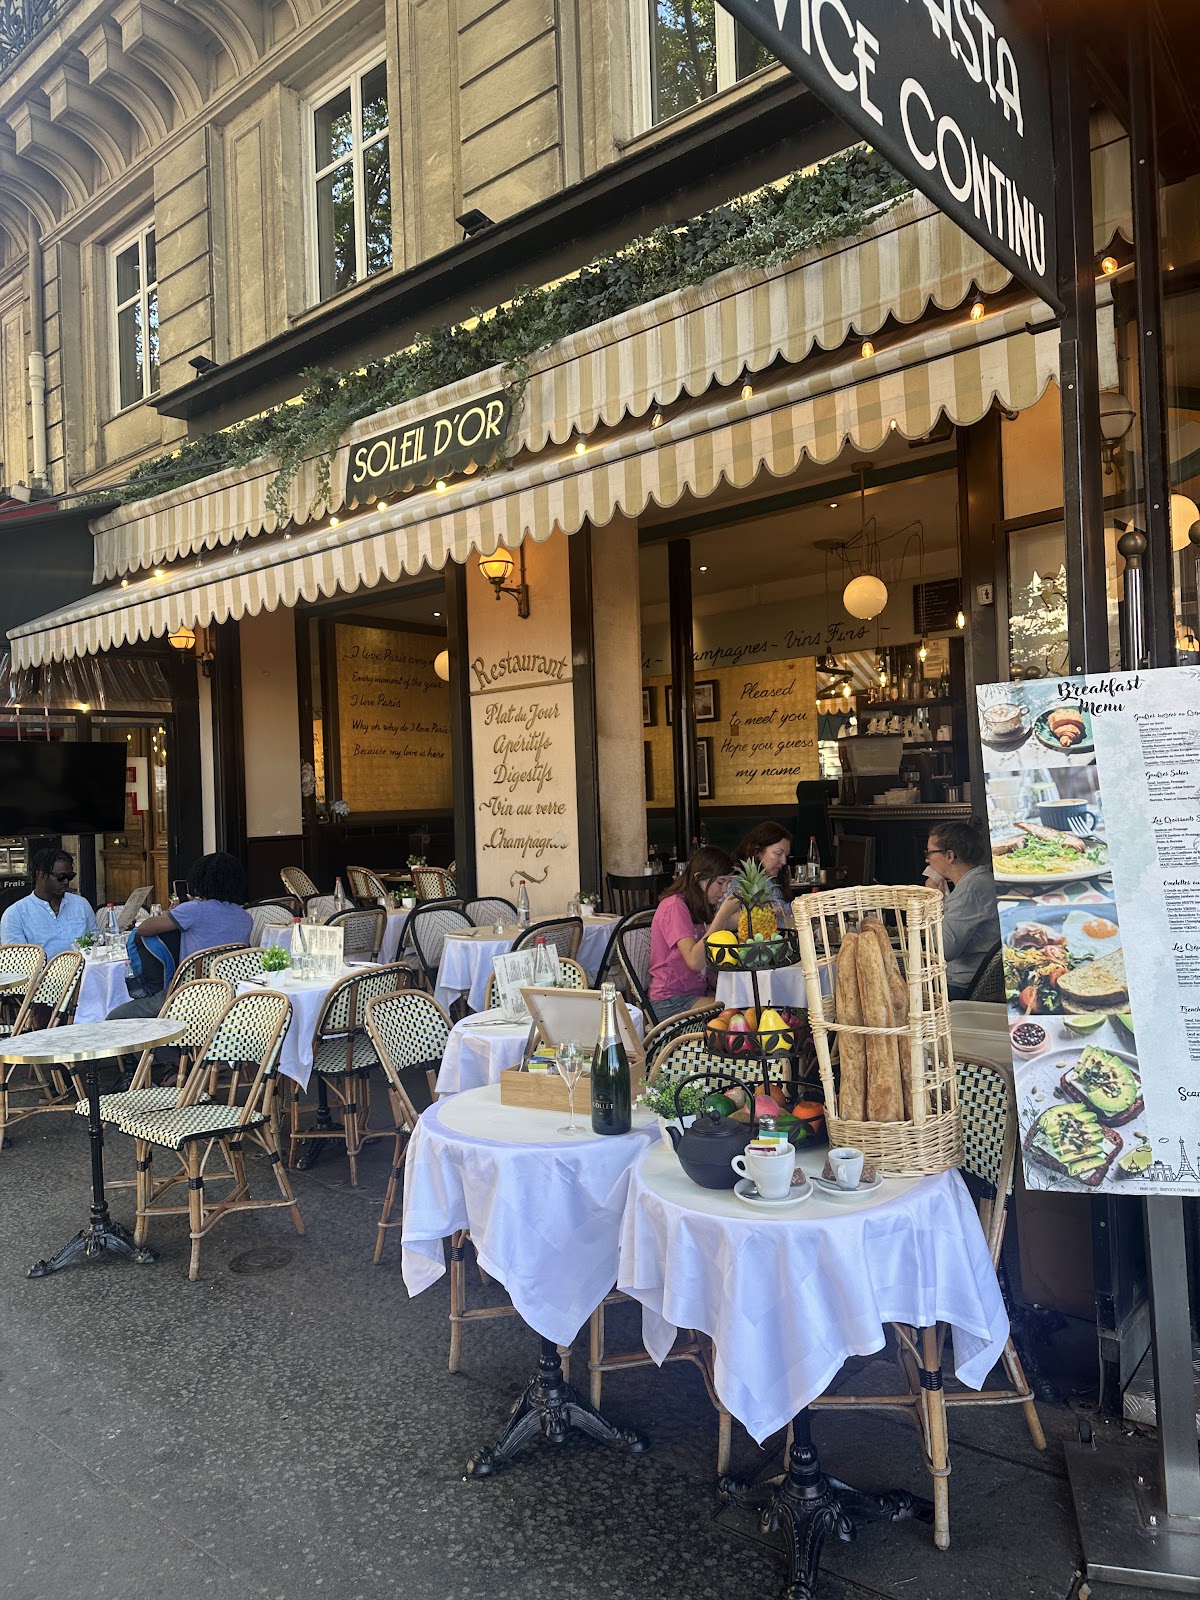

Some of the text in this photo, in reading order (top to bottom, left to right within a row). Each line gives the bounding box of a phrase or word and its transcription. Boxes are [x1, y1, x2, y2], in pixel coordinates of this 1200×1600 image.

[904, 0, 1024, 137] ASTA
[900, 77, 1046, 277] CONTINU
[352, 400, 504, 483] SOLEIL D'OR
[362, 645, 381, 661] love
[383, 648, 406, 663] Paris
[692, 640, 769, 667] ampagnes
[784, 627, 821, 650] Vins
[351, 671, 373, 686] Every
[374, 674, 402, 686] moment
[403, 674, 411, 690] of
[411, 676, 423, 686] the
[471, 651, 568, 691] Restaurant
[740, 678, 796, 700] Pleased
[1057, 674, 1145, 702] Breakfast
[359, 693, 375, 706] love
[377, 693, 401, 708] Paris
[1078, 698, 1126, 717] Menu
[484, 702, 561, 731] Plat du Jour
[729, 707, 808, 728] to meet you
[352, 719, 369, 735] Why
[382, 722, 399, 737] why
[400, 722, 409, 732] do
[415, 723, 430, 733] love
[353, 743, 445, 759] Because my love is here
[493, 731, 553, 763] Apéritifs
[720, 738, 815, 758] Hope you guess
[493, 761, 554, 793] Digestifs
[735, 764, 801, 784] my name
[479, 795, 566, 816] Vin au verre
[3, 880, 26, 888] Frais
[592, 1101, 614, 1109] COLLET
